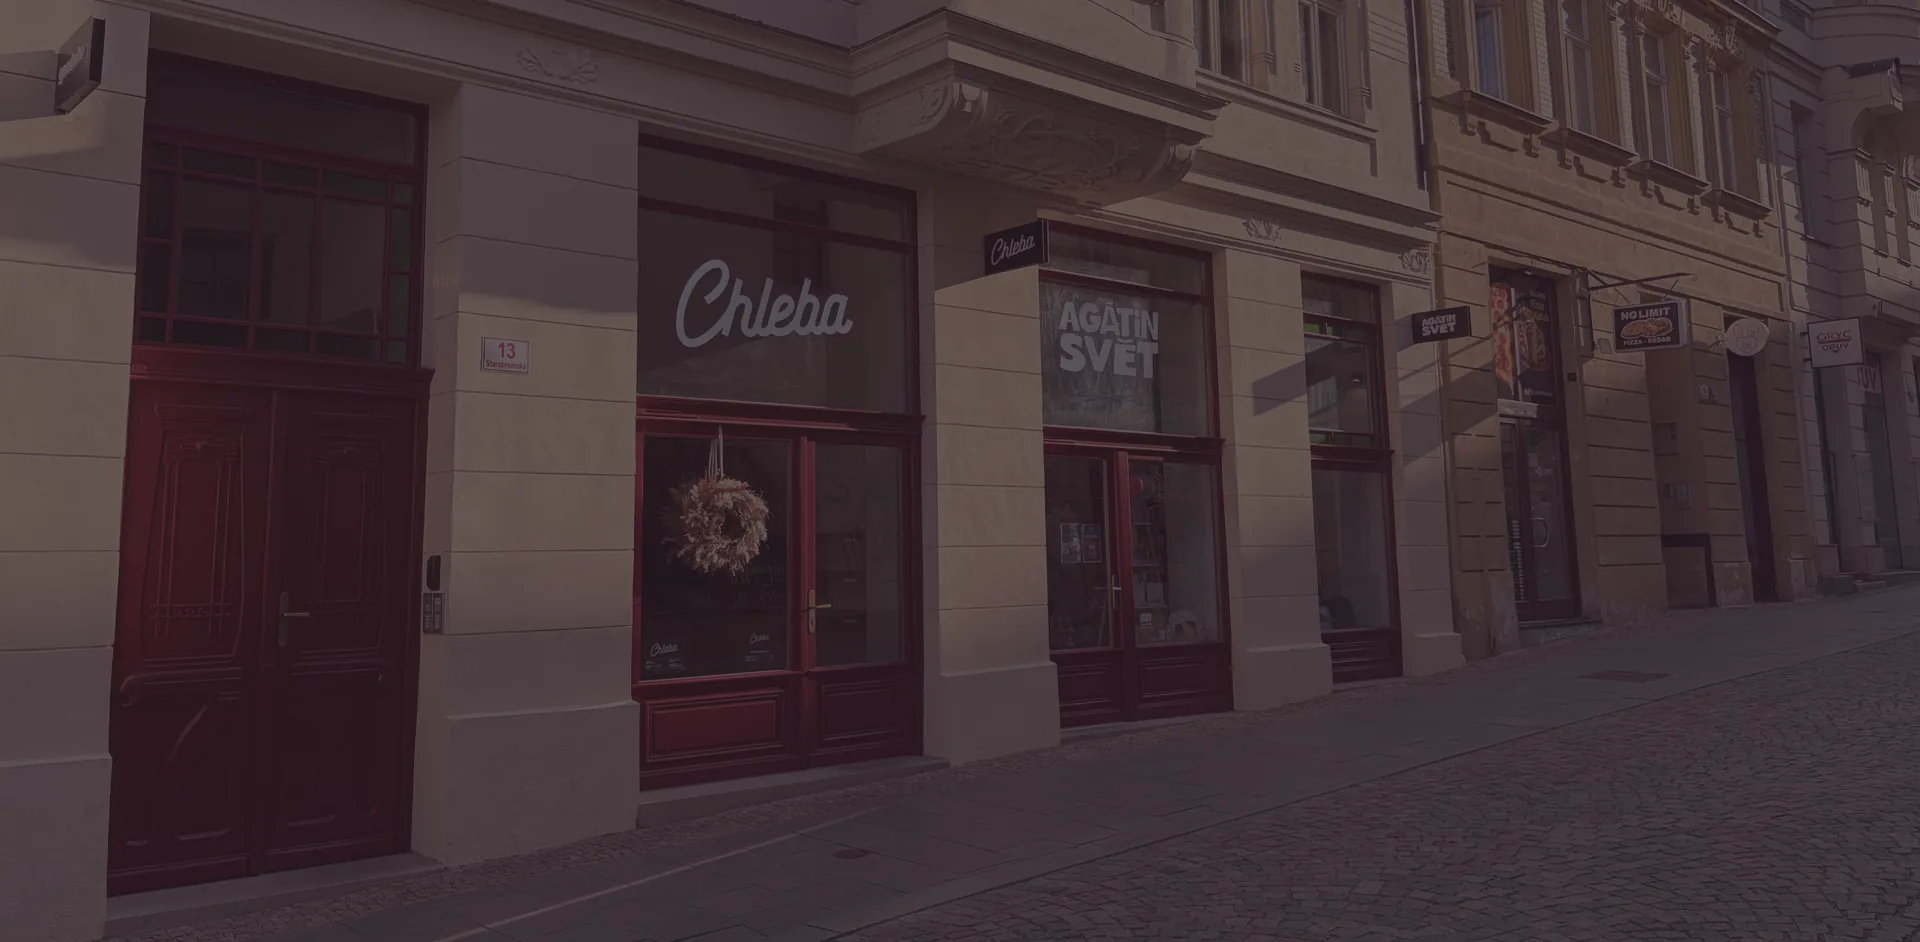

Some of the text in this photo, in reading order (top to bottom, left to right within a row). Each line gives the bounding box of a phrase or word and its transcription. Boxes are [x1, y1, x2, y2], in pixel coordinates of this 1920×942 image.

[991, 234, 1036, 266] Chleba
[675, 259, 854, 348] Chleba
[498, 342, 516, 359] 13
[1822, 343, 1849, 351] OBUV
